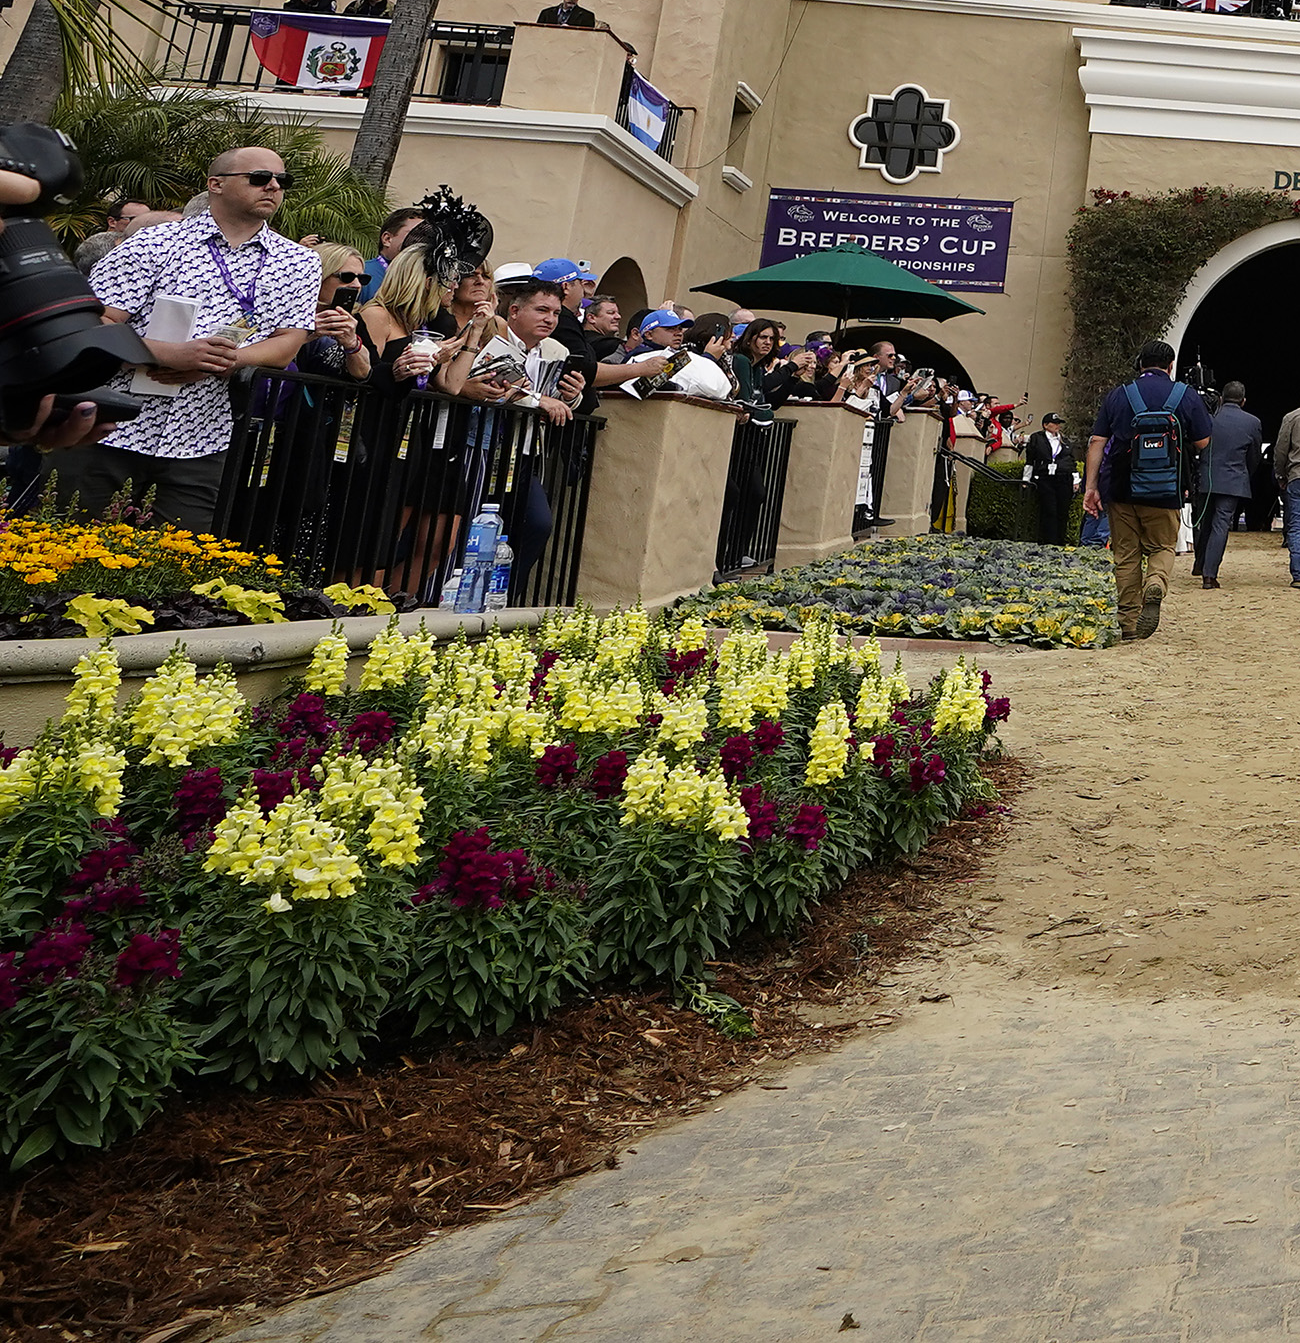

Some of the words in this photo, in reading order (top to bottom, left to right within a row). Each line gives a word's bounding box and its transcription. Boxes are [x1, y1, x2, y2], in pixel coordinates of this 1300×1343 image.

[823, 210, 901, 226] WELCOME
[906, 216, 925, 228] TO
[931, 217, 960, 228] THE
[777, 227, 929, 252] BREEDERS'
[939, 236, 997, 256] CUP
